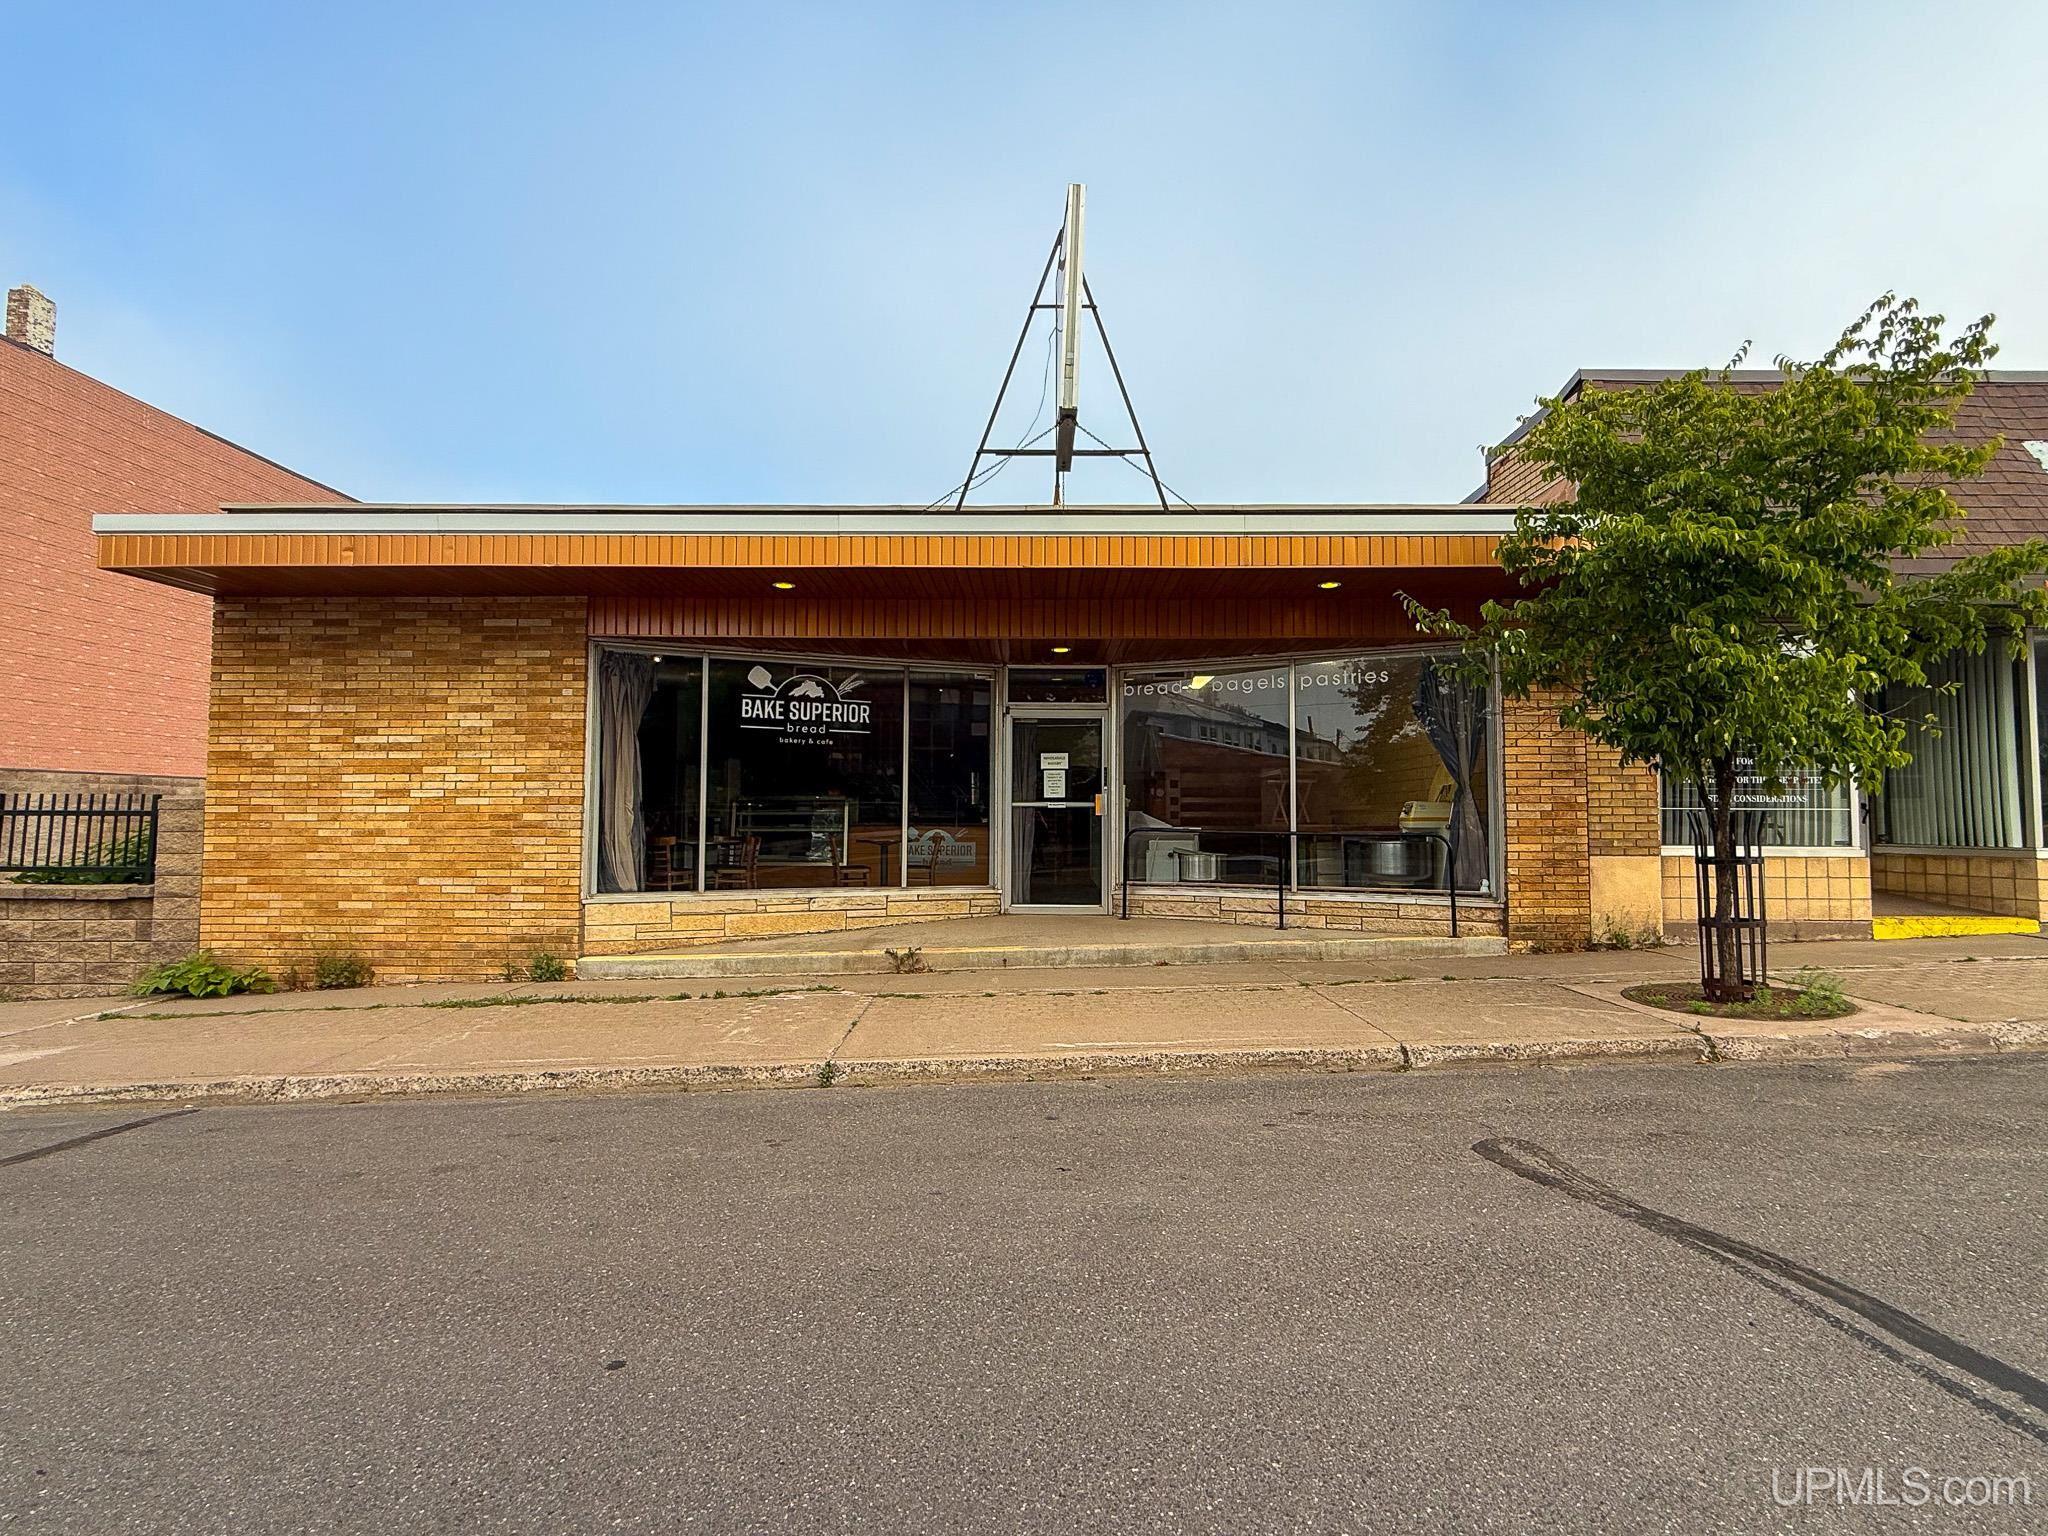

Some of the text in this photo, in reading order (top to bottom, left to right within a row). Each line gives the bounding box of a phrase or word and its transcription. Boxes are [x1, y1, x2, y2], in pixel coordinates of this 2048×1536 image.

[1123, 669, 1389, 697] bread bagels pastries
[741, 698, 870, 723] BAKE SUPERIOR
[787, 722, 826, 734] bread
[779, 737, 805, 745] bakery
[1736, 757, 1754, 765] FOR
[908, 844, 973, 856] AKE SPERIOR
